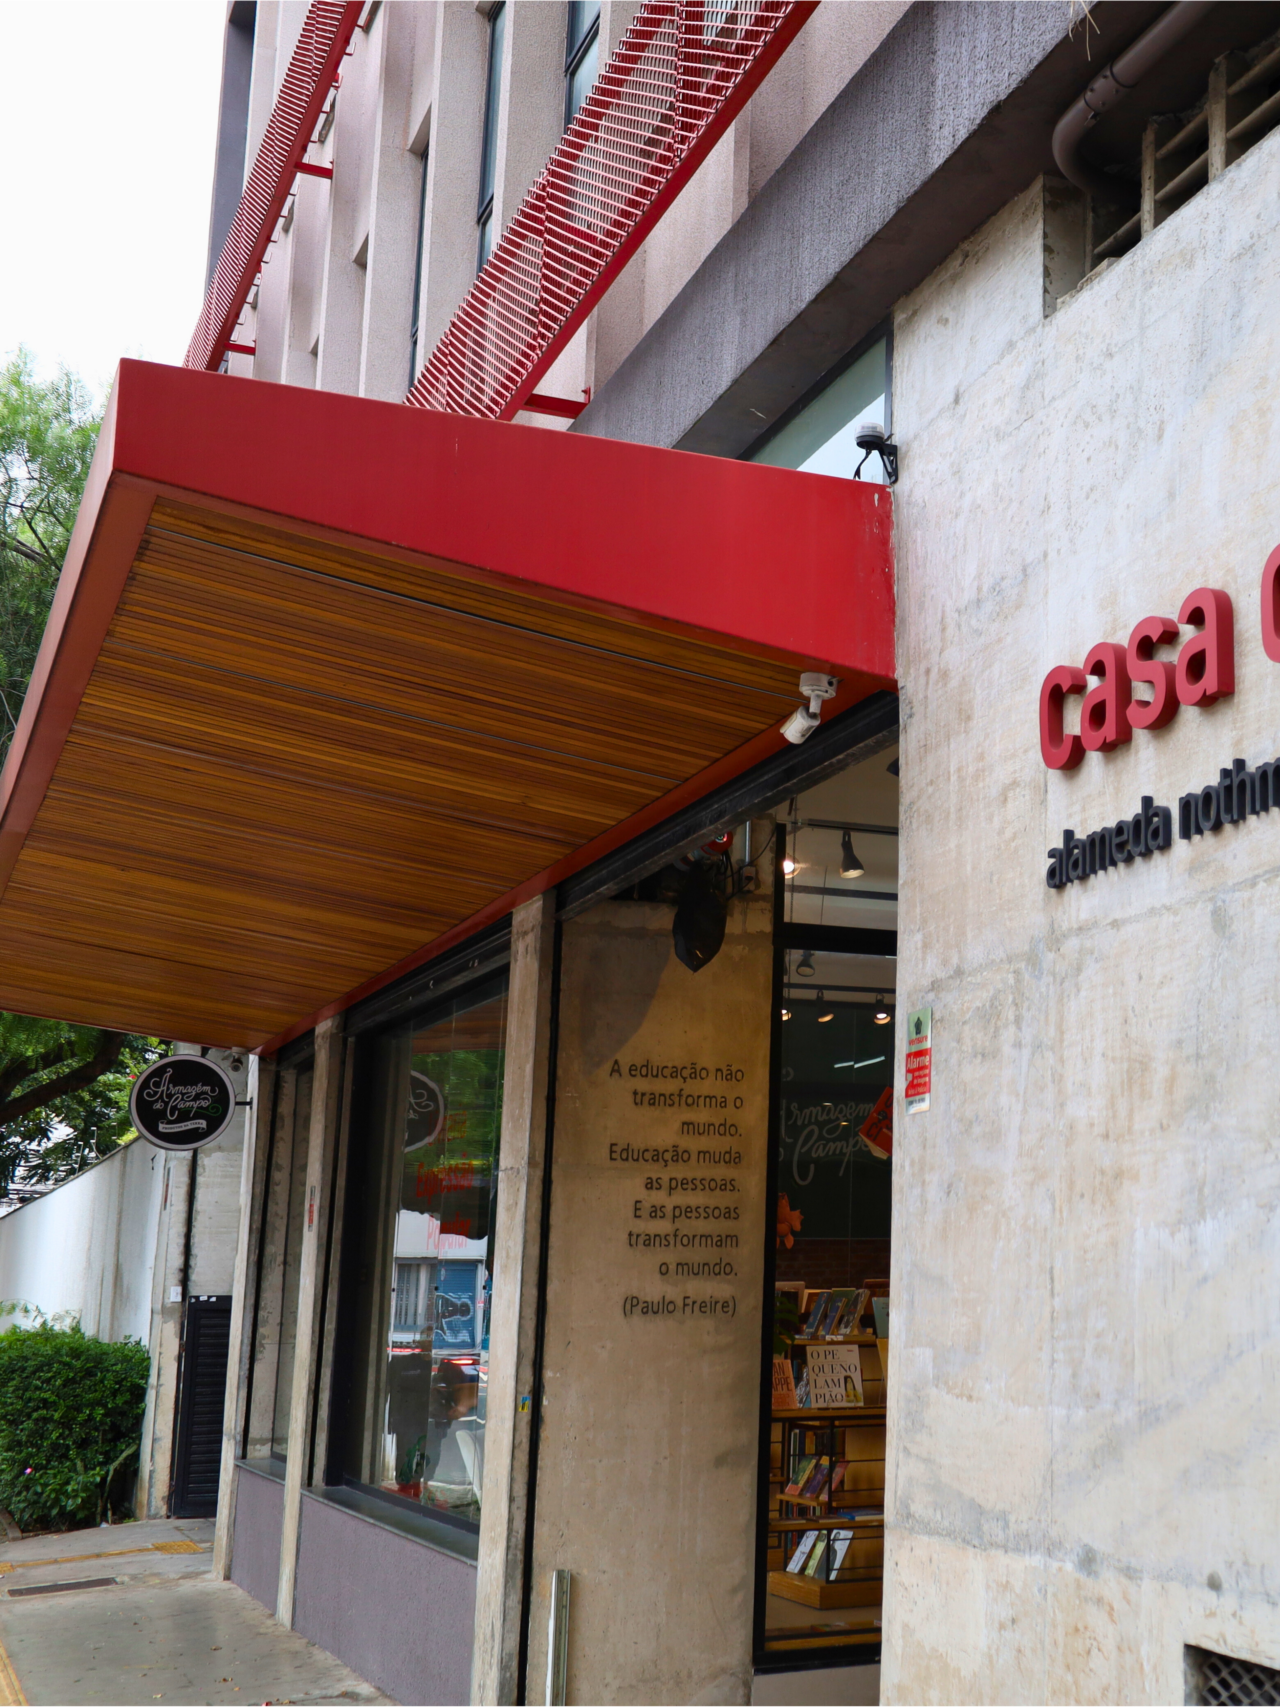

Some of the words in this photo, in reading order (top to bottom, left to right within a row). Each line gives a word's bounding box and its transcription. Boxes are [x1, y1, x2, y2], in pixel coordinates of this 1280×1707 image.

[1039, 587, 1236, 770] casa
[1046, 796, 1172, 888] alameda
[609, 1059, 622, 1077] A
[628, 1059, 709, 1083] educação
[715, 1064, 744, 1082] não
[907, 1055, 929, 1070] Alarme
[152, 1099, 164, 1109] do
[167, 1094, 212, 1120] Campo
[632, 1088, 727, 1109] transforma
[734, 1096, 743, 1110] o
[681, 1118, 742, 1137] mundo.
[609, 1143, 691, 1167] Educação
[697, 1146, 741, 1164] muda
[415, 1152, 474, 1204] Expressão
[645, 1177, 662, 1190] as
[669, 1176, 740, 1196] pessoas.
[634, 1200, 642, 1218] E
[649, 1205, 666, 1218] as
[673, 1205, 739, 1224] pessoas
[426, 1211, 471, 1257] Popular
[628, 1228, 738, 1248] transformam
[659, 1262, 669, 1276] o
[676, 1257, 737, 1277] mundo.
[623, 1295, 676, 1317] (Paulo
[683, 1295, 736, 1318] Freire)
[811, 1350, 820, 1360] O
[823, 1349, 840, 1360] PE
[812, 1363, 858, 1377] QUENO
[814, 1378, 841, 1389] LAM
[815, 1390, 844, 1404] PIÃO
